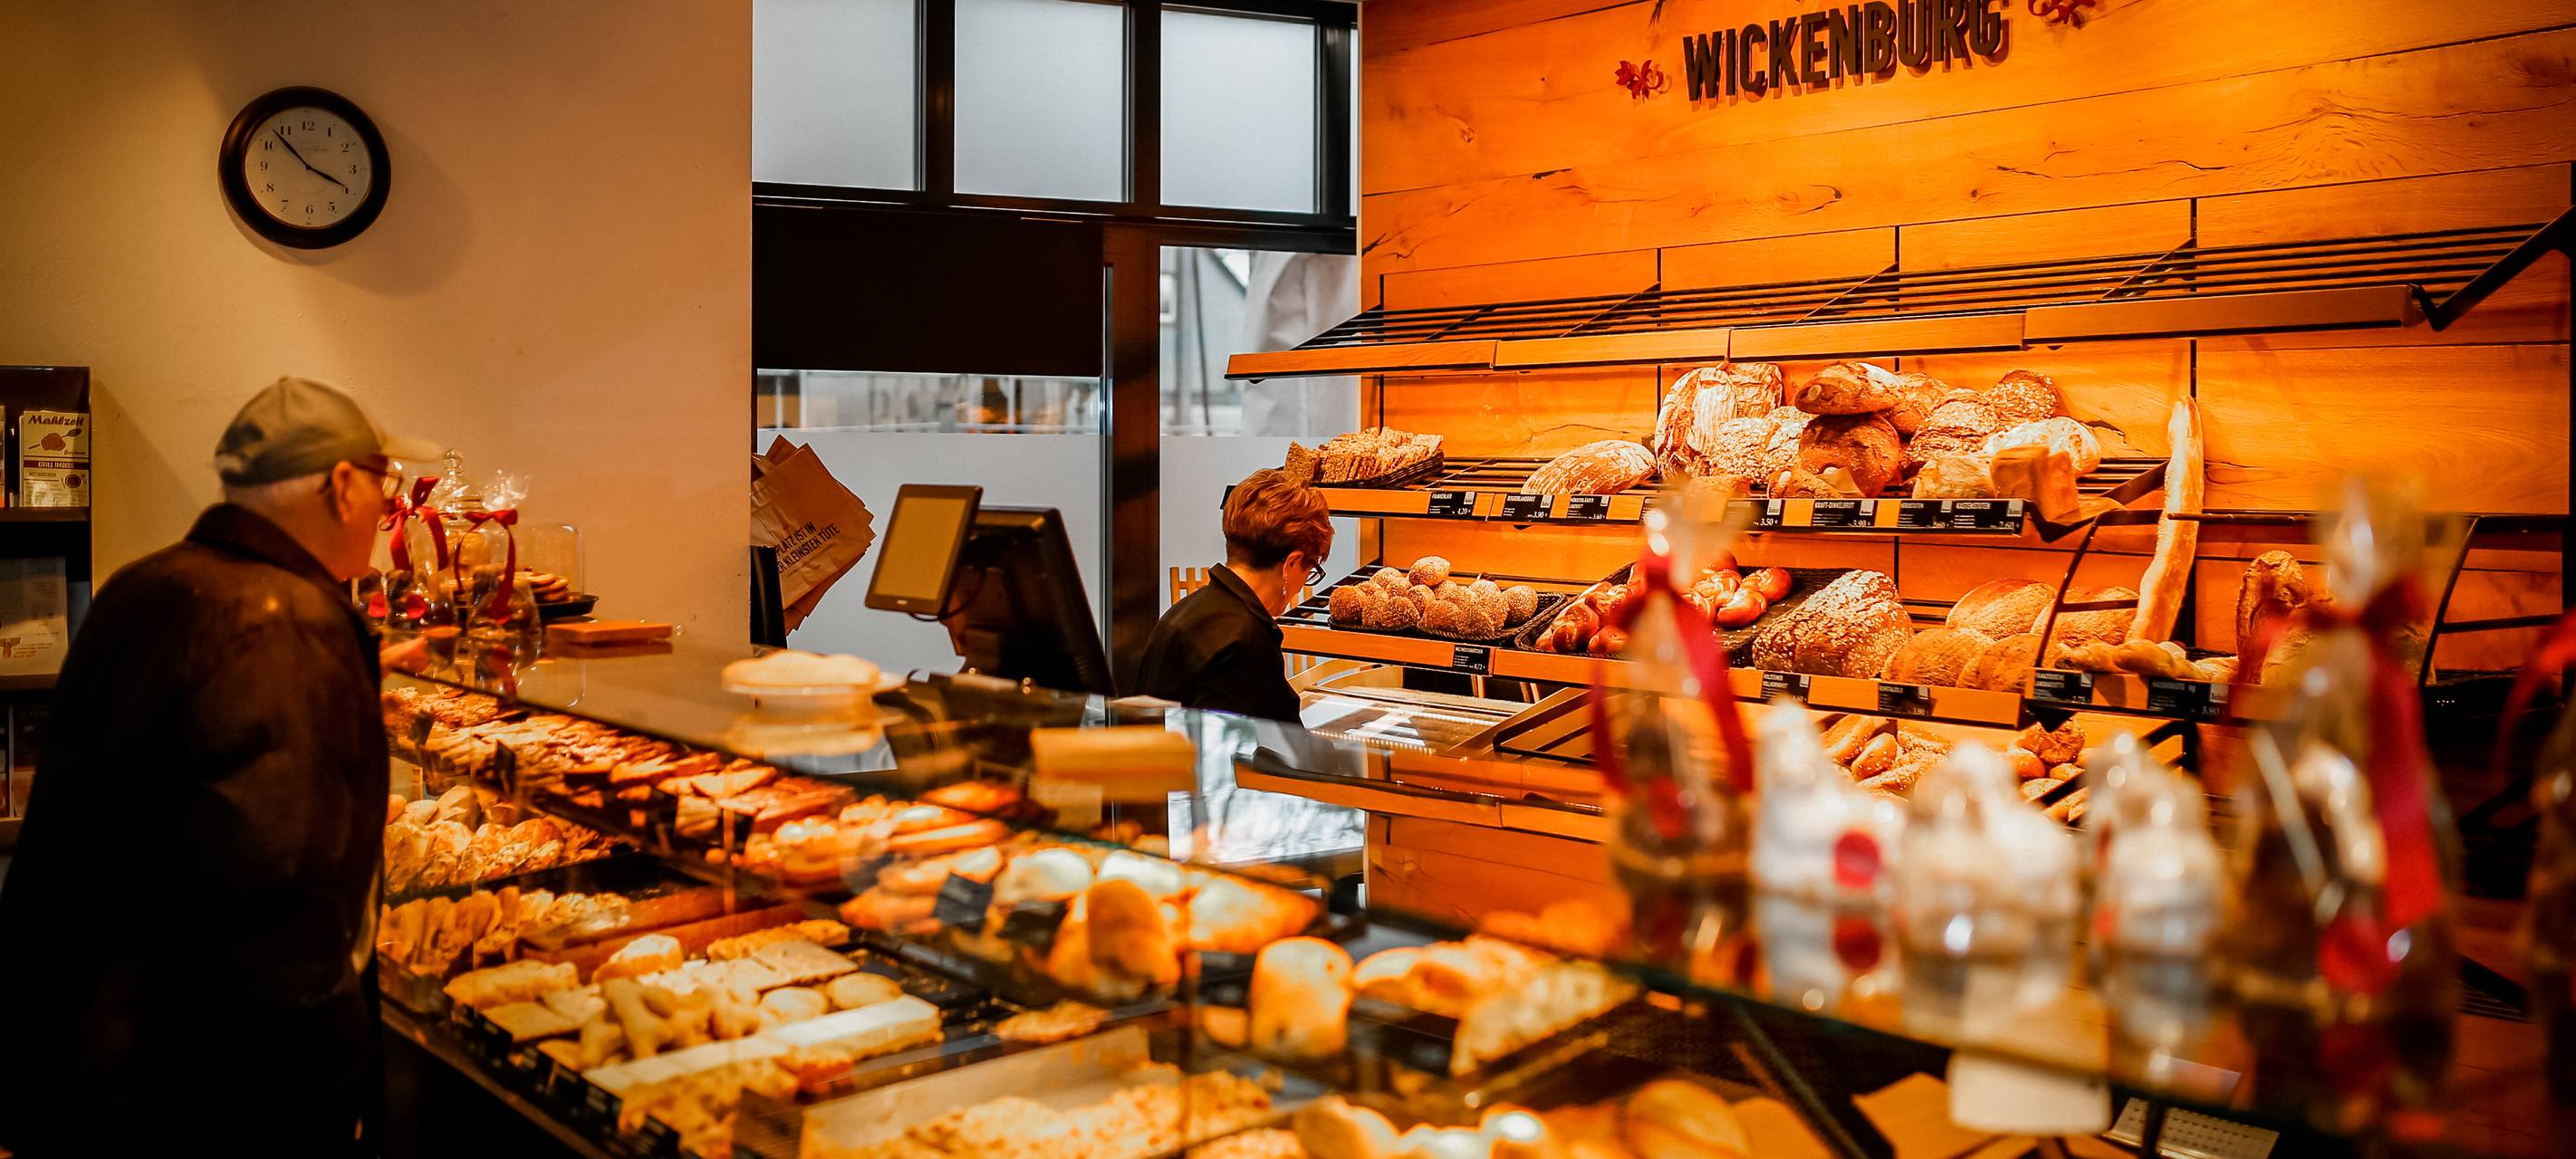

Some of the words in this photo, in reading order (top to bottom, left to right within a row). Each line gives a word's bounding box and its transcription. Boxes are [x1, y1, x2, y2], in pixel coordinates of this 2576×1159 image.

[1683, 0, 2003, 101] WICKENBURG
[302, 120, 315, 131] 12
[280, 126, 292, 136] 11
[264, 140, 274, 150] 10
[341, 142, 349, 152] 2
[260, 161, 268, 171] 9
[349, 164, 356, 174] 3
[266, 183, 274, 193] 8
[305, 205, 313, 215] 6
[327, 201, 335, 211] 5
[28, 415, 84, 426] Mahlzeit
[792, 528, 809, 542] IST
[805, 521, 816, 535] IN
[783, 535, 822, 568] KLEINSTEN
